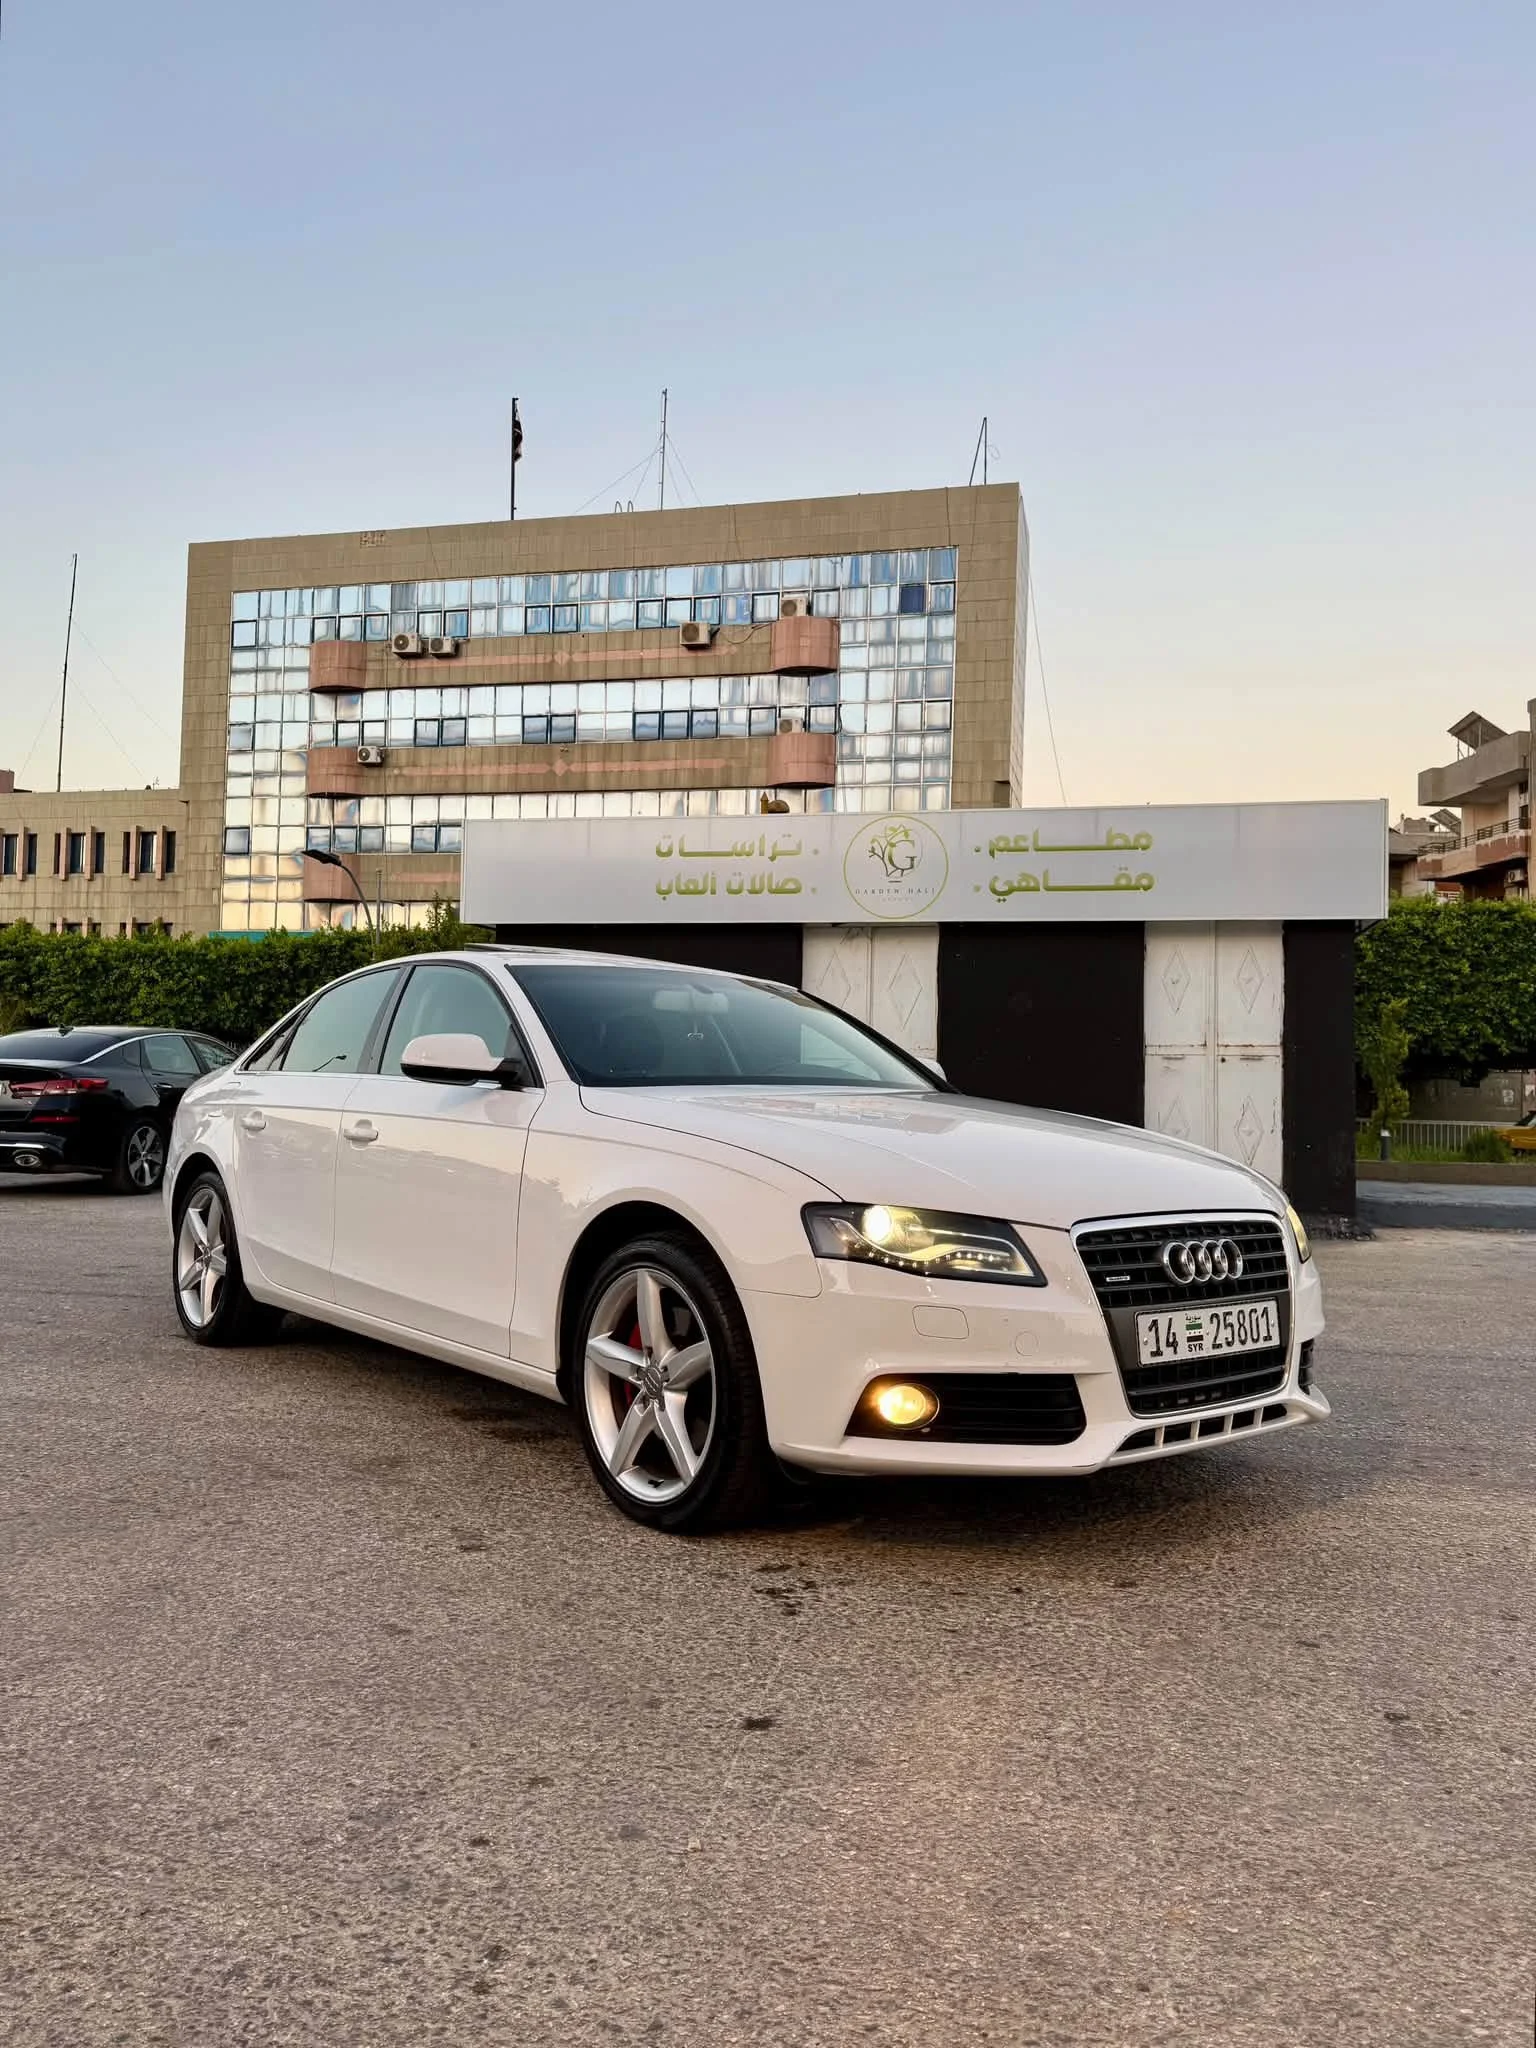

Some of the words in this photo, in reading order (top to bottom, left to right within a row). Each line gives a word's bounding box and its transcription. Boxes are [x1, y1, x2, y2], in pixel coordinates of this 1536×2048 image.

[655, 833, 802, 862] تراسات
[988, 826, 1153, 859] مطاعم
[655, 871, 717, 901] ألعاب
[726, 871, 802, 895] صالات
[988, 866, 1155, 903] مقاهي
[1148, 1317, 1178, 1358] 14
[1209, 1306, 1273, 1350] 25801
[1187, 1342, 1203, 1352] SYR
